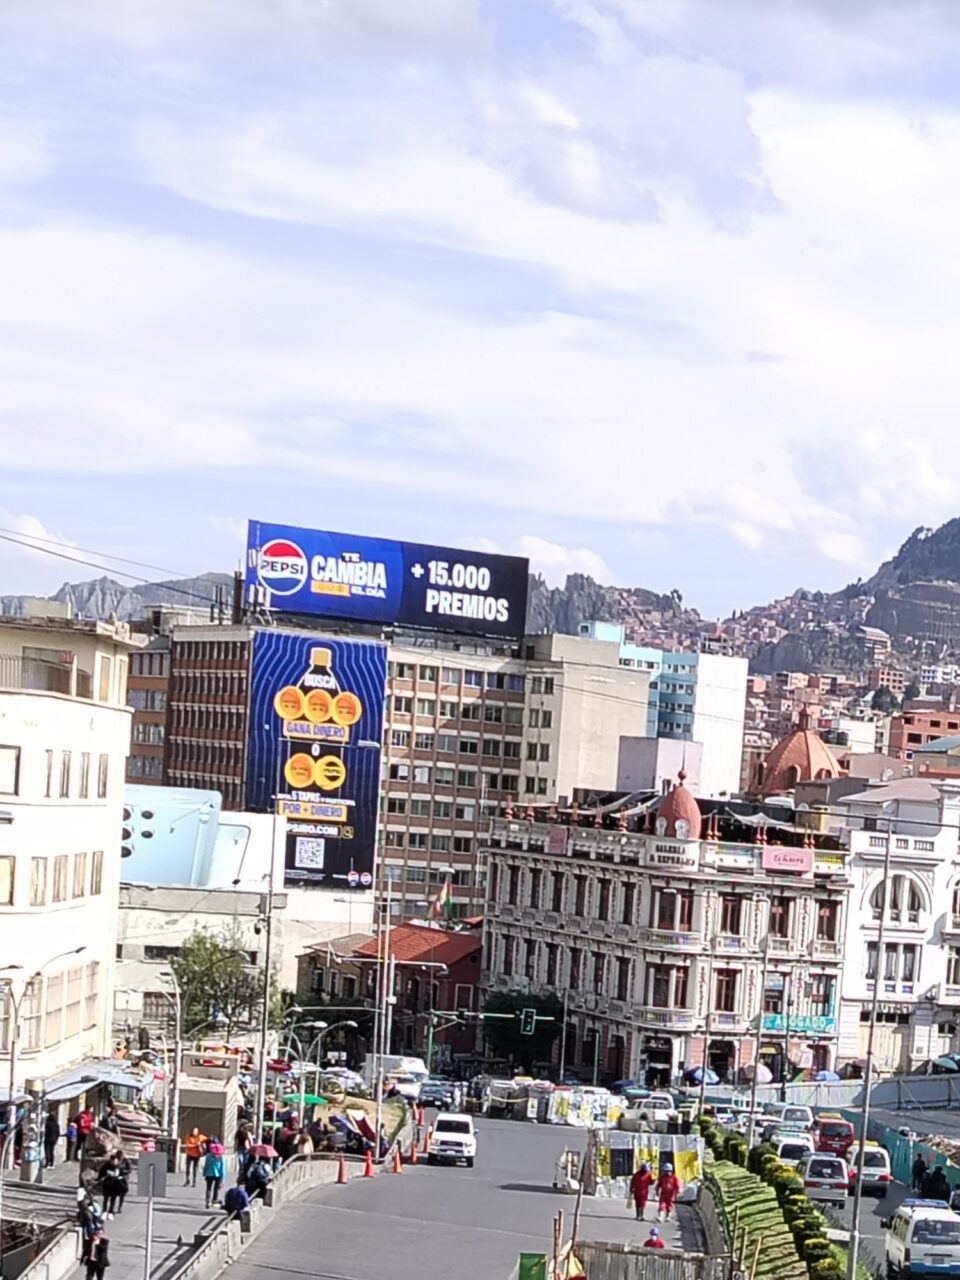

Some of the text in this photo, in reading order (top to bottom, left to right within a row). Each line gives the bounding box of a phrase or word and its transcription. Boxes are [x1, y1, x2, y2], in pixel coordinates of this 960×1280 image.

[261, 559, 304, 575] PEPSI
[311, 555, 387, 588] CAMBIA
[428, 560, 490, 590] 15.000
[425, 588, 508, 622] PREMIOS
